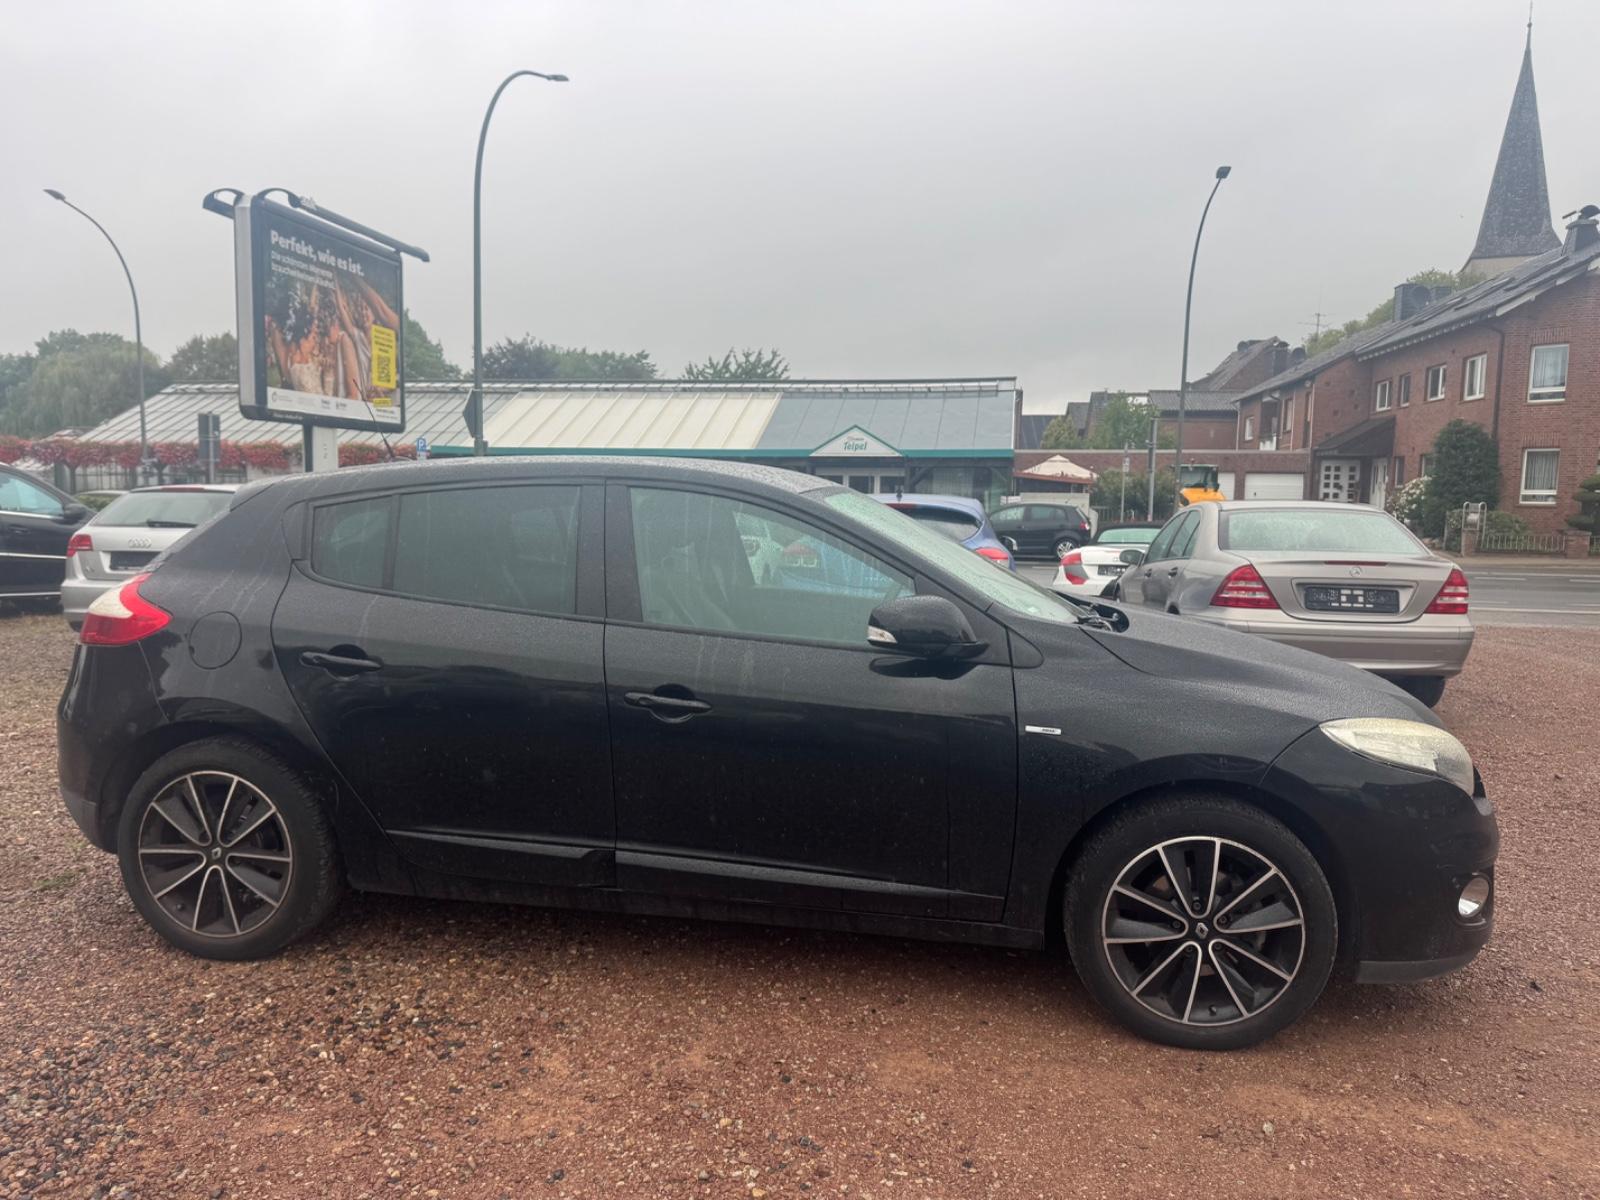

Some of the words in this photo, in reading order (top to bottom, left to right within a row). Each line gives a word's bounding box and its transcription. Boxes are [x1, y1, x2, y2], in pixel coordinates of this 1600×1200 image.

[271, 229, 317, 261] Perfekt,
[317, 249, 336, 266] wie
[337, 258, 348, 270] es
[348, 256, 365, 277] ist.
